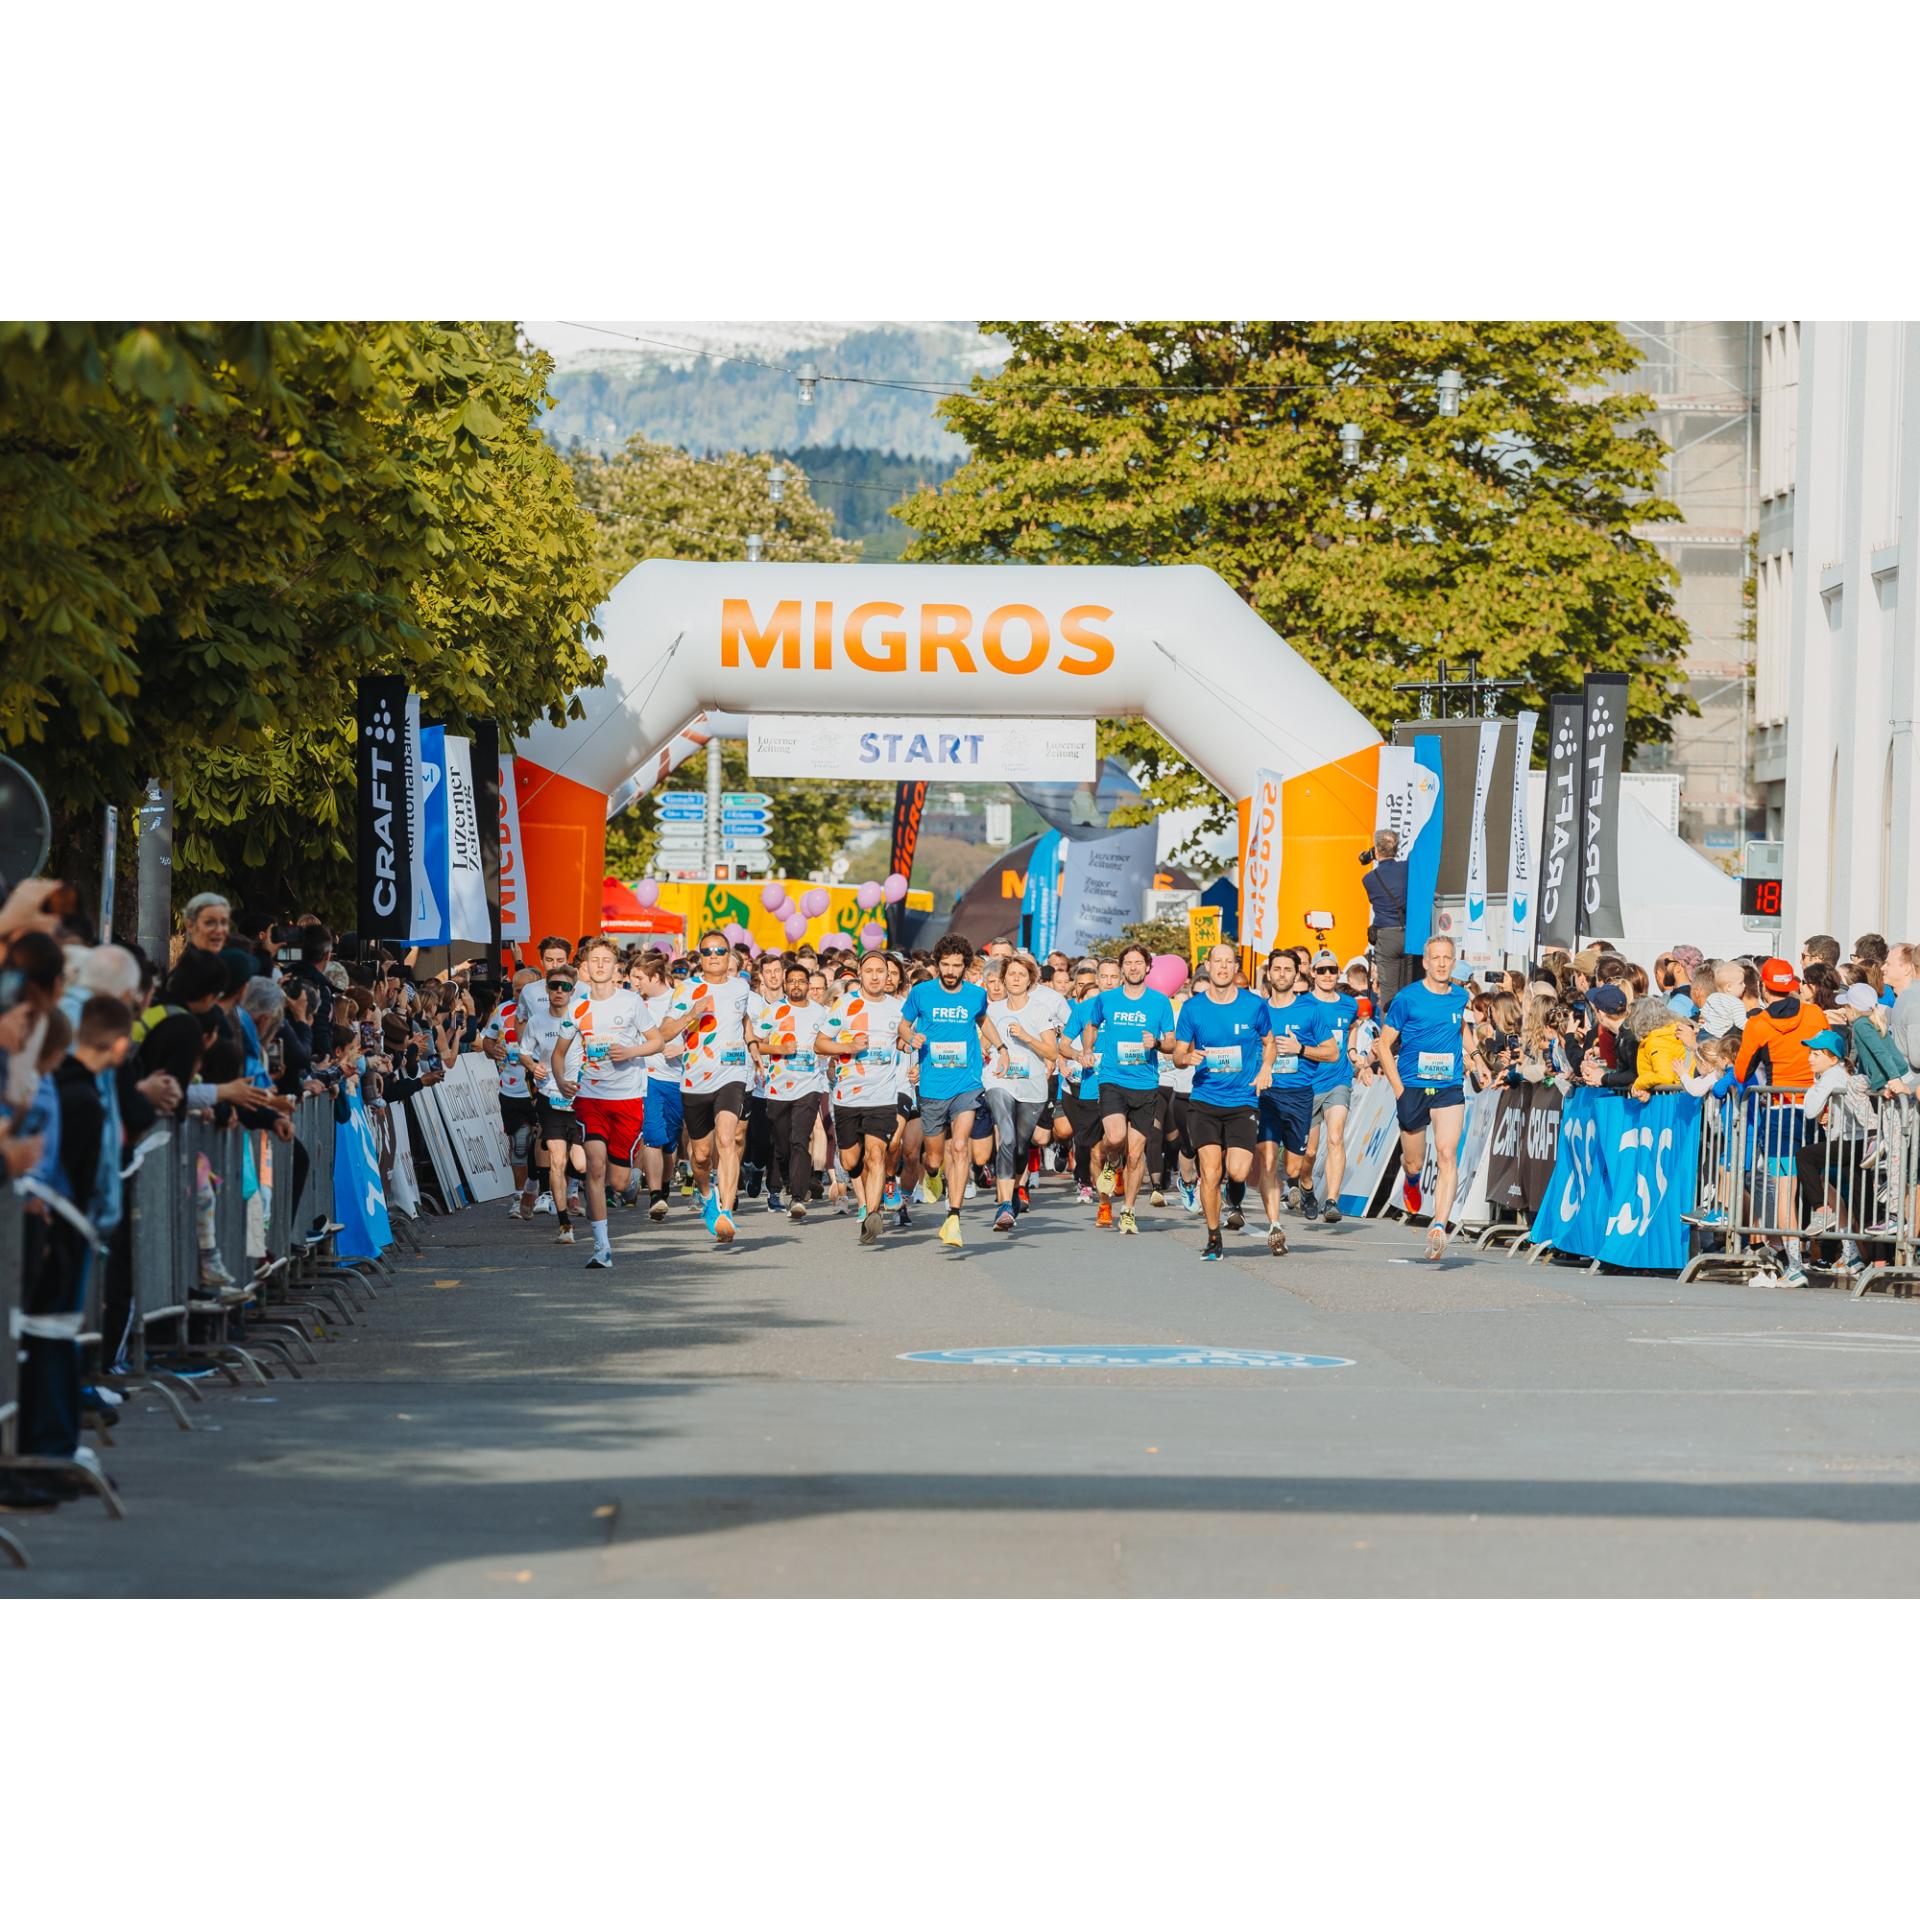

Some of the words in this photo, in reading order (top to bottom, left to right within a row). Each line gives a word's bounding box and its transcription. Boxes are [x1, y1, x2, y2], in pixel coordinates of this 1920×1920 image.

[720, 598, 1116, 676] MIGROS
[858, 731, 985, 765] START
[371, 747, 397, 917] CRAFT
[450, 766, 469, 870] Luzerner
[464, 785, 481, 873] Zeitung
[500, 768, 517, 925] MIGR
[901, 780, 928, 879] IGRO
[1756, 881, 1780, 914] 18
[1527, 1106, 1560, 1161] CRAFT
